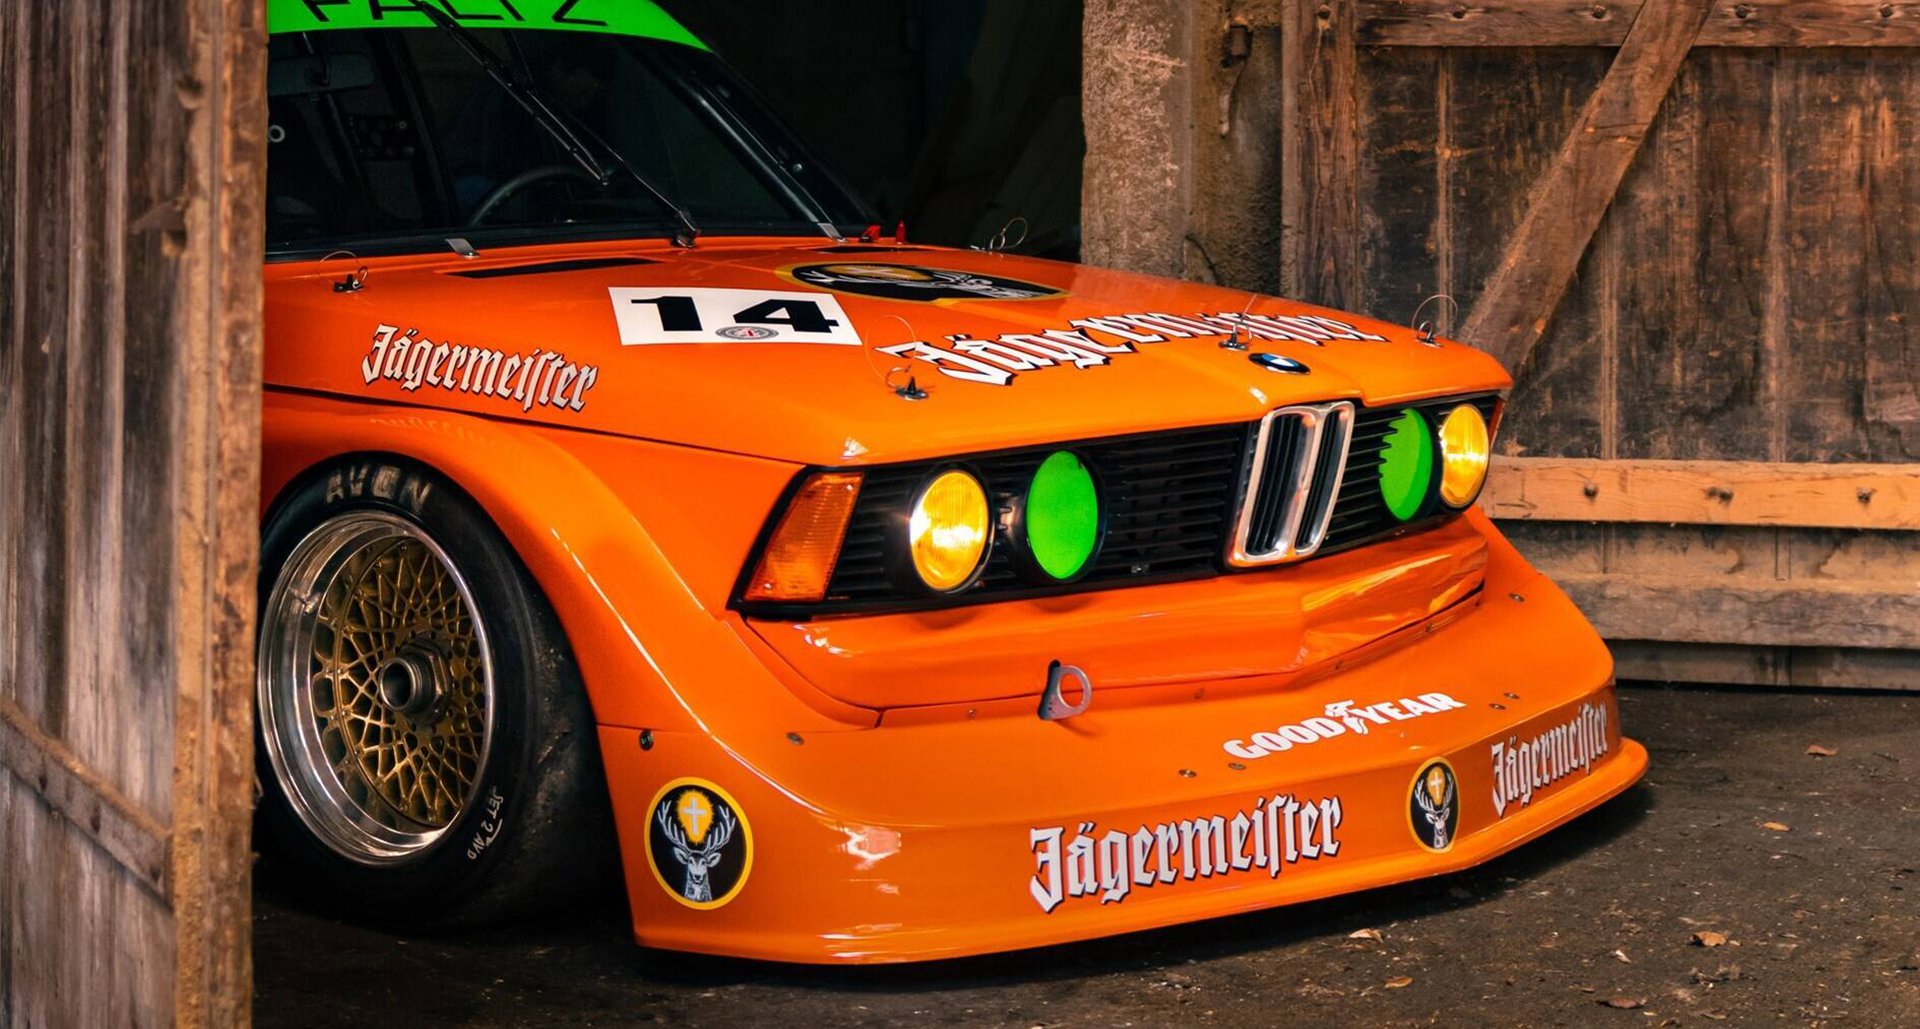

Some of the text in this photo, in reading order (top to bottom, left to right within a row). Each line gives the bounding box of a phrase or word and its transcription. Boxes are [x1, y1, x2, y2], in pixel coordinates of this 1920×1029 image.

[630, 295, 840, 334] 14
[361, 323, 600, 413] Jägermeister
[325, 463, 433, 513] AVON
[1029, 794, 1343, 914] Jägermeister
